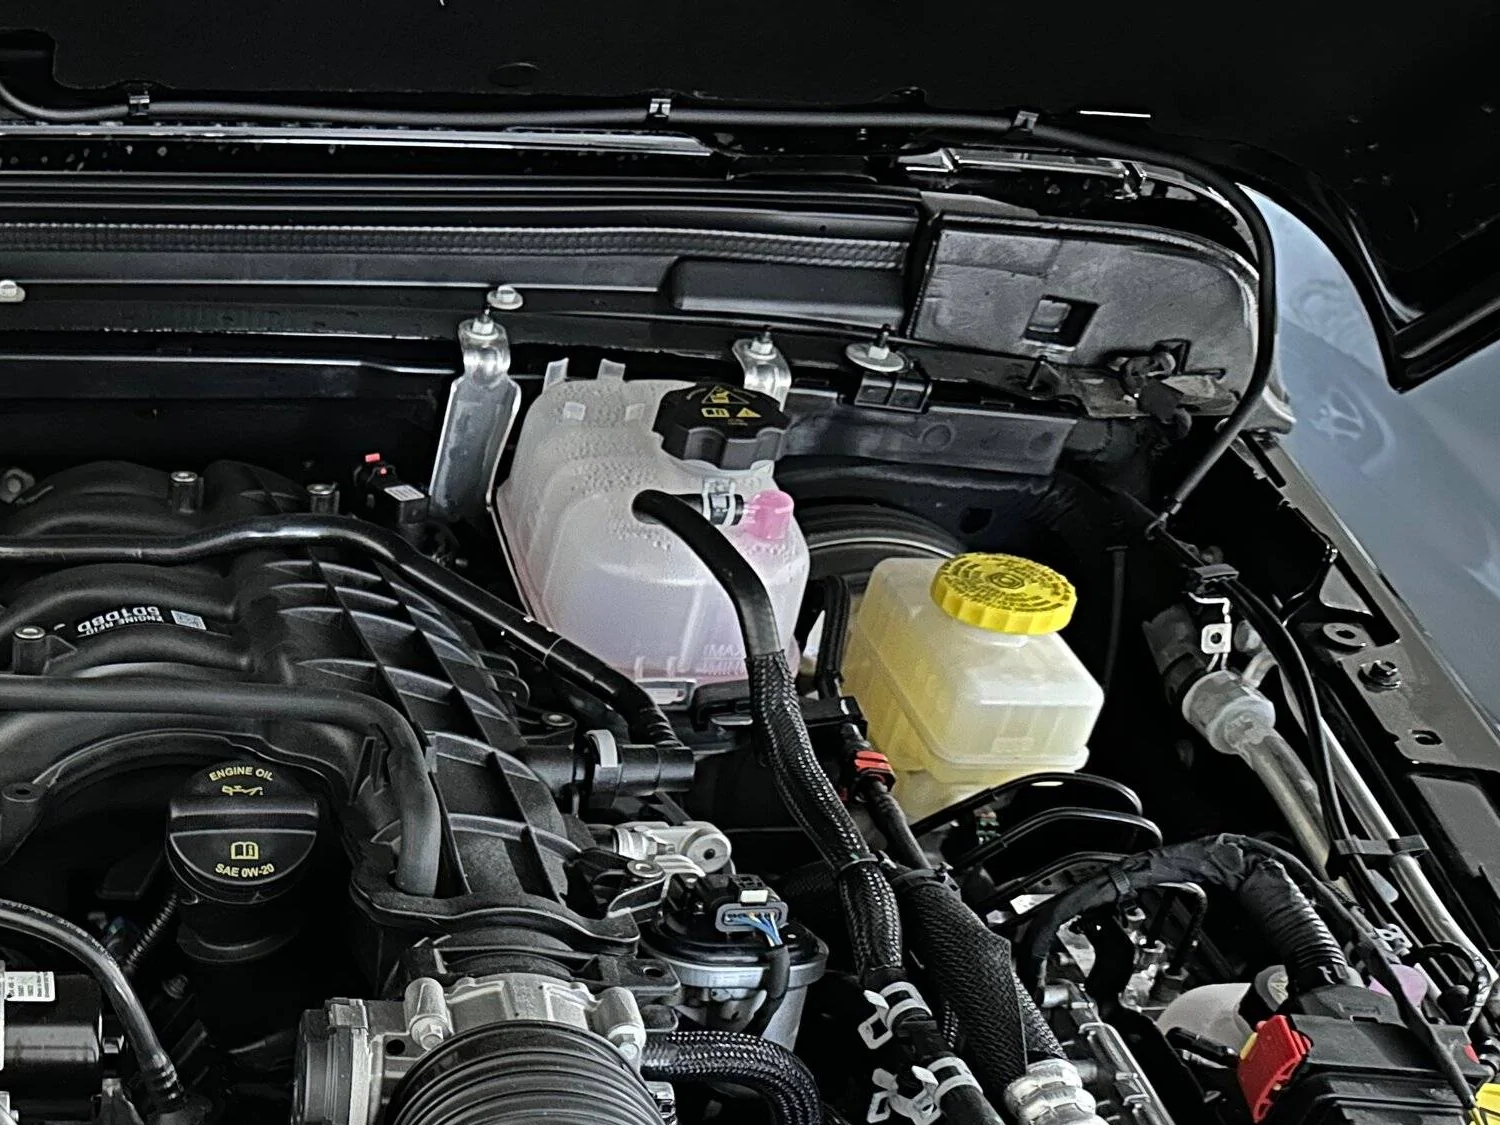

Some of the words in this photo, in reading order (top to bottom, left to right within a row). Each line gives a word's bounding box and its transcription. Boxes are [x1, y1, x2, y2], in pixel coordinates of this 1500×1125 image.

[209, 766, 253, 781] ENGINE
[256, 768, 273, 781] OIL
[215, 863, 239, 877] SAE
[241, 863, 275, 877] 0W-20
